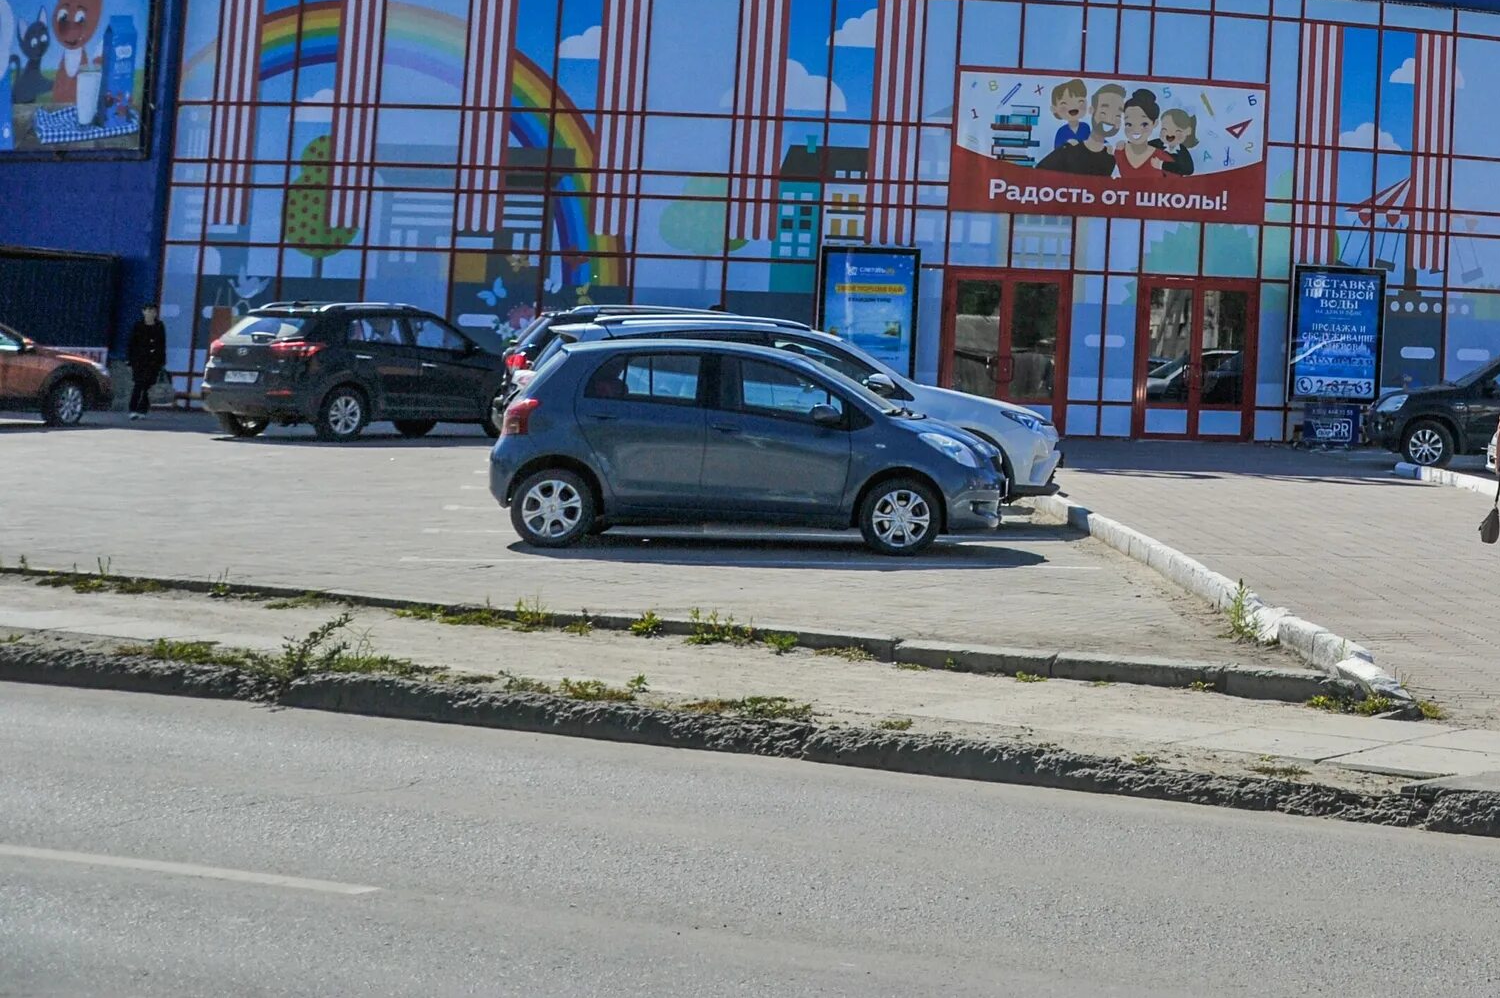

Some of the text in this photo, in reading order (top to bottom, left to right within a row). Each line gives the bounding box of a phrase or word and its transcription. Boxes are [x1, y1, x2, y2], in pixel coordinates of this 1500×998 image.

[988, 179, 1228, 211] Радость от школы!
[1304, 278, 1375, 291] ДОСТАВКА
[1305, 288, 1374, 300] ПИТЬЕВОЙ
[1320, 299, 1358, 309] ВОДЫ
[1312, 323, 1366, 333] ПРОДАЖА И
[1316, 379, 1372, 395] 2-87-63
